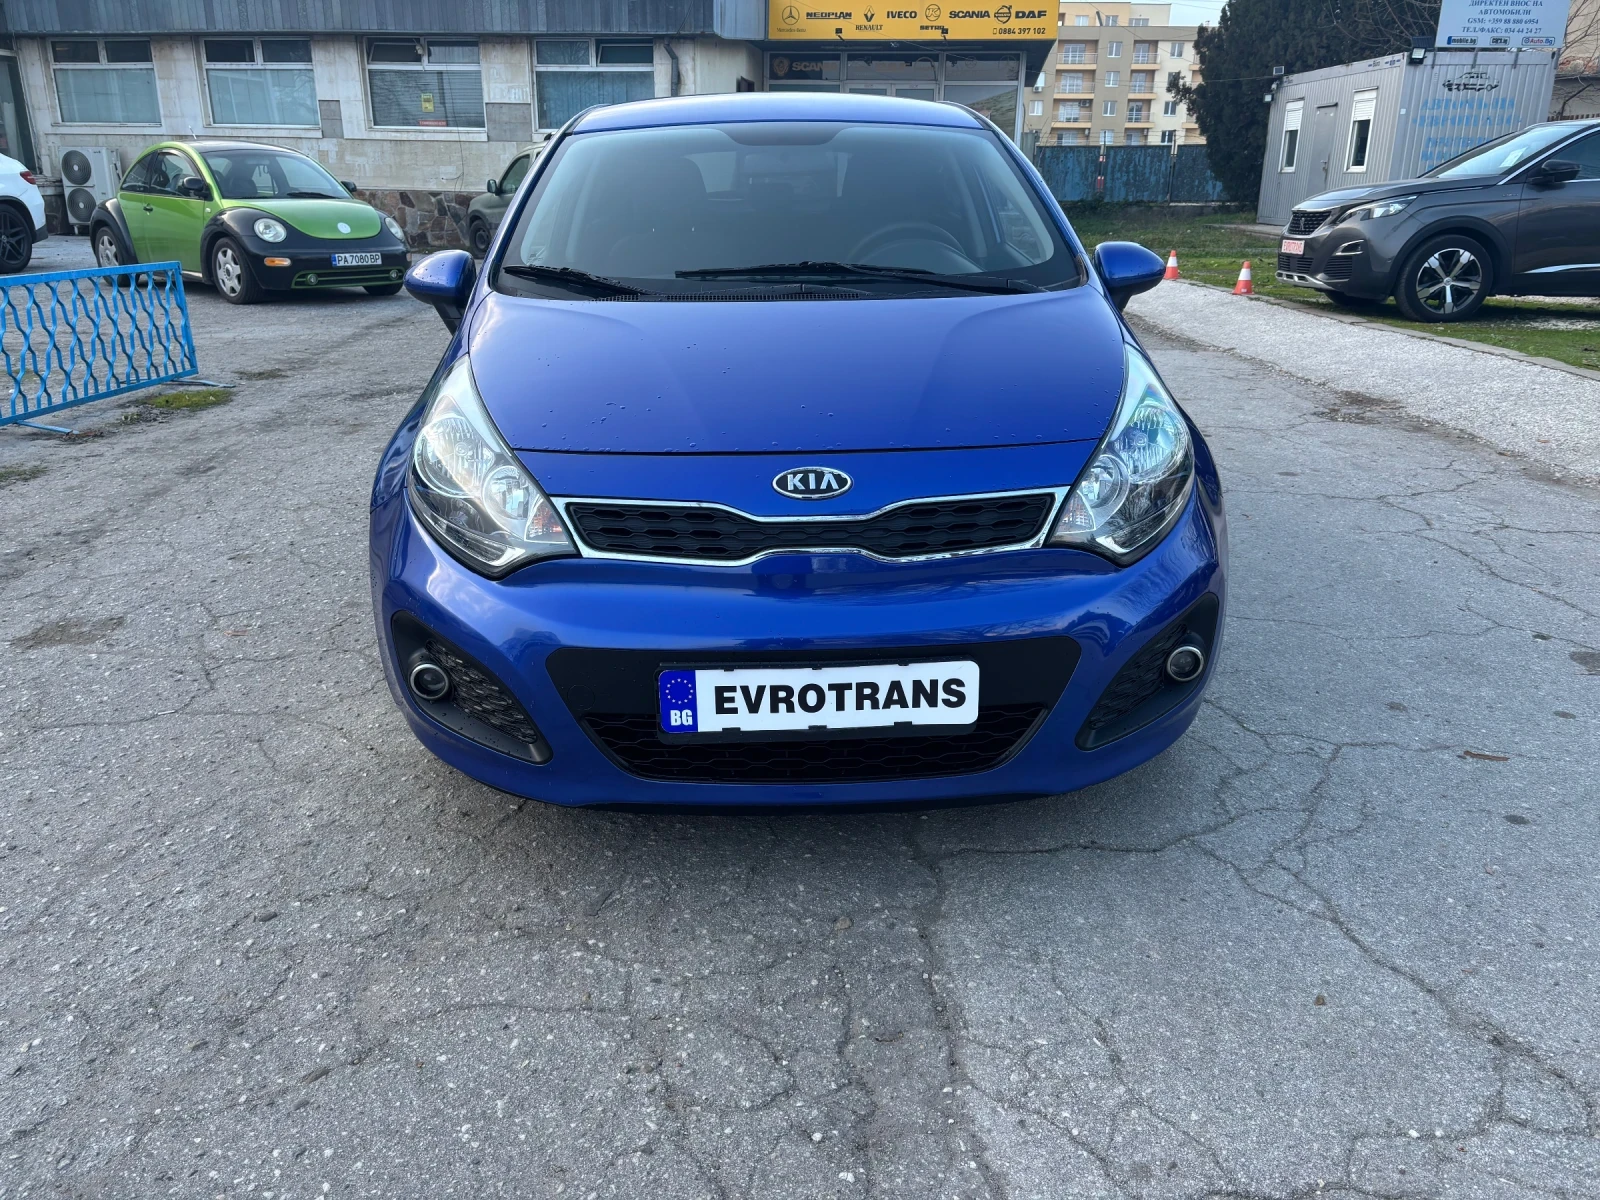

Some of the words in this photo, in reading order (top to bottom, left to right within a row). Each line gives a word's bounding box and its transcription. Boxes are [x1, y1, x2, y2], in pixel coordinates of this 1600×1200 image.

[887, 10, 917, 19] IVECO
[949, 10, 990, 18] SCANIA
[1015, 10, 1047, 19] DAF
[792, 61, 837, 71] SCAN
[787, 472, 839, 491] KIA
[714, 678, 967, 715] EVROTRANS
[670, 710, 693, 727] BG
